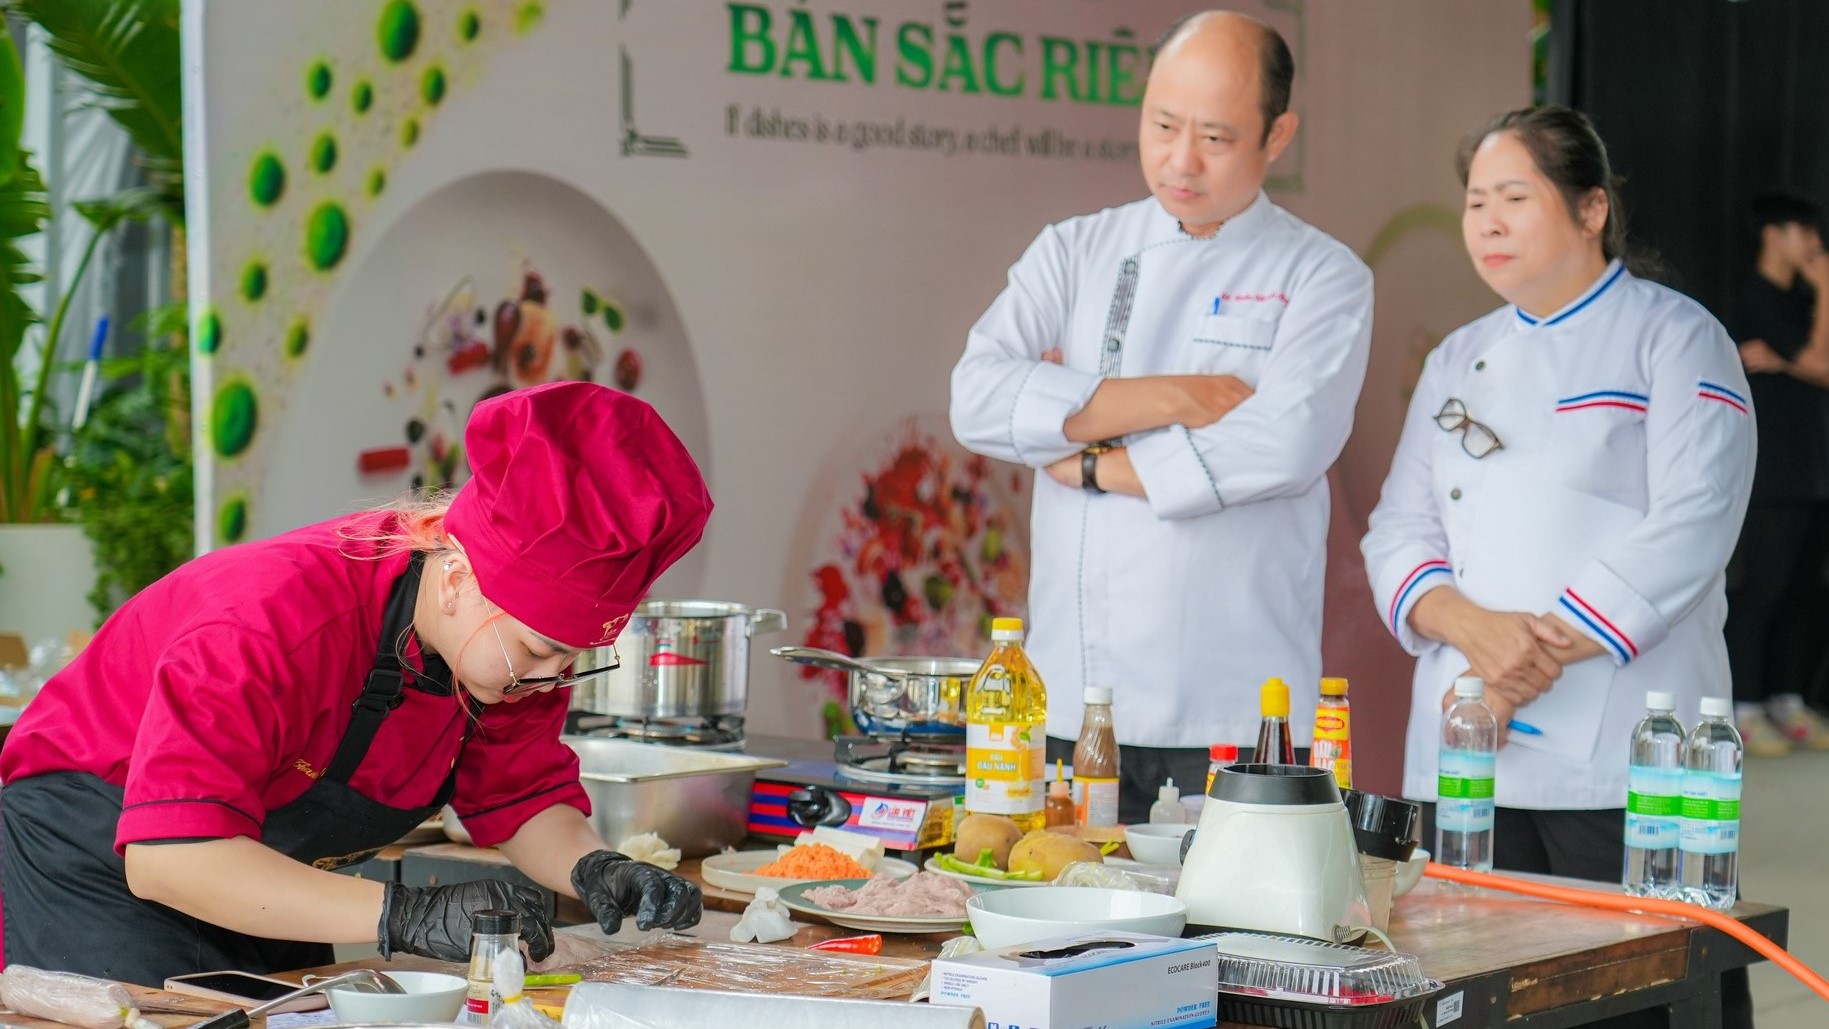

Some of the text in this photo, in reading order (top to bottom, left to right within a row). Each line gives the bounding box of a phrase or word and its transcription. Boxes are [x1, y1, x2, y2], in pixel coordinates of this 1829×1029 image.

[1040, 27, 1156, 107] RIÊ
[1167, 962, 1190, 975] ECOCARE
[1176, 1001, 1211, 1014] POWDER FREE
